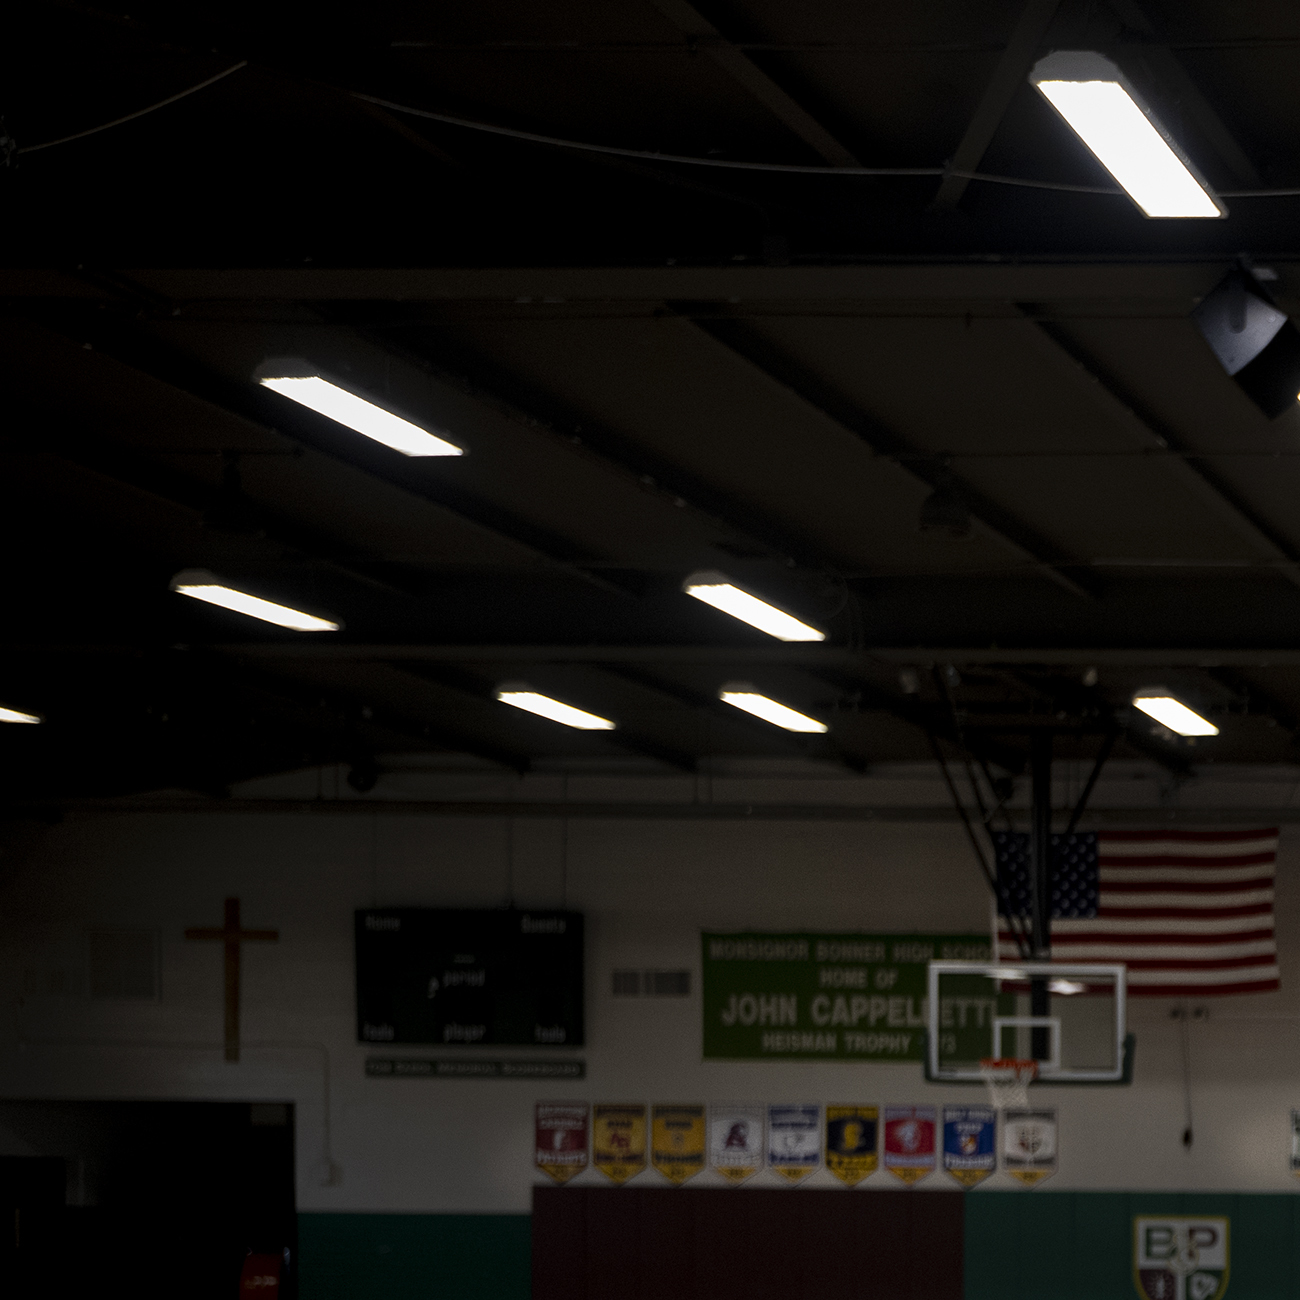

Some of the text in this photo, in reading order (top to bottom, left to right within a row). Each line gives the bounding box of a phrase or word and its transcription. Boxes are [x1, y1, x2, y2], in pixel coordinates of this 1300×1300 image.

[709, 939, 809, 961] MONSIGNOR
[815, 940, 886, 962] BONNER
[892, 942, 935, 962] HIGH
[819, 967, 899, 990] HOME OF
[721, 993, 797, 1027] JOHN
[761, 1031, 838, 1054] HEISMAN
[843, 1032, 912, 1054] TROPHY
